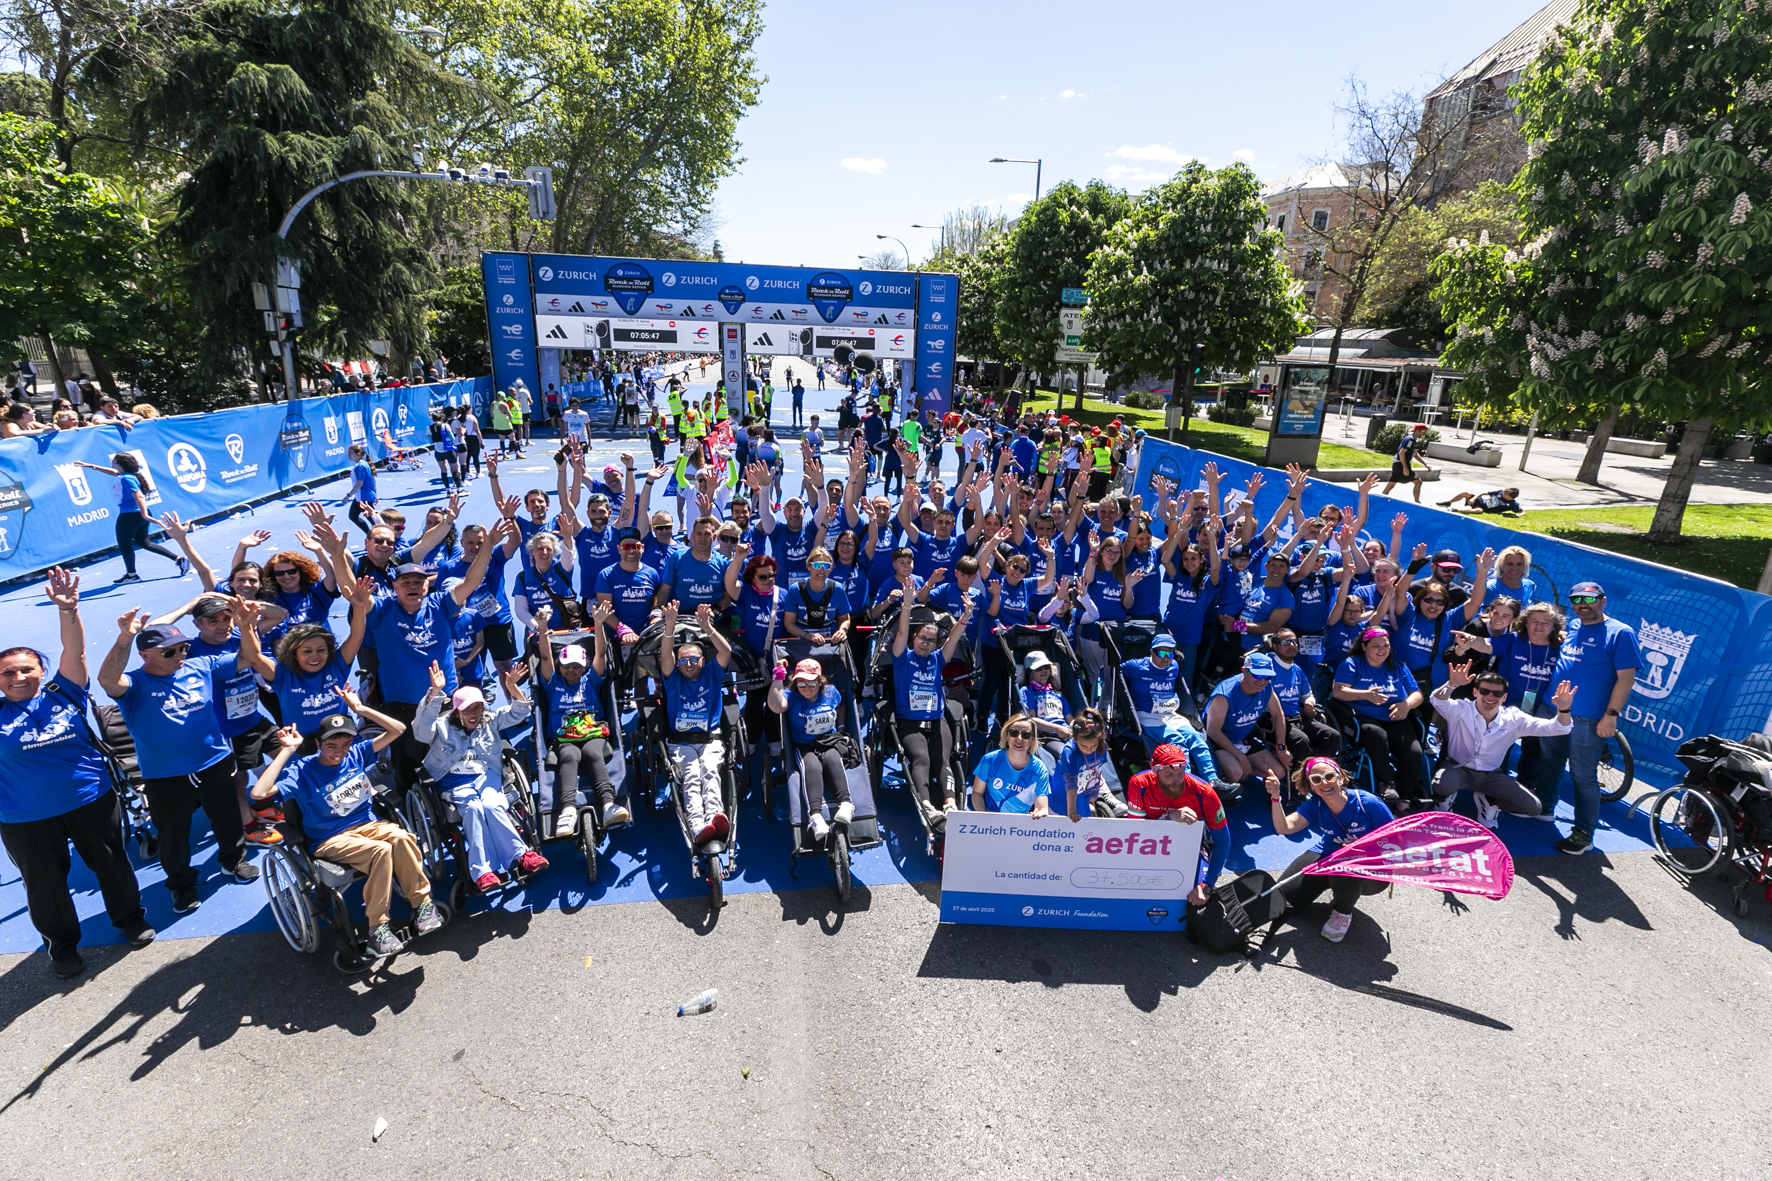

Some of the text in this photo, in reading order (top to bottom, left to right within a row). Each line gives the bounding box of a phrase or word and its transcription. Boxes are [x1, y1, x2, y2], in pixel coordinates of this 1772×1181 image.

[558, 270, 597, 280] ZURICH
[680, 275, 718, 285] ZURICH
[764, 280, 800, 289] ZURICH
[876, 285, 911, 294] ZURICH
[496, 307, 524, 315] ZURICH
[924, 323, 949, 331] ZURICH
[630, 332, 660, 340] 07:05:47
[325, 446, 345, 457] MADRID
[176, 470, 207, 485] MAPOMA
[67, 507, 110, 528] MADRID
[235, 693, 255, 704] 12032
[815, 717, 830, 725] SARA
[1619, 704, 1684, 742] DRID
[22, 733, 76, 751] #Imparables
[334, 770, 357, 787] ZURICH
[958, 824, 1075, 840] Z Zurich Foundation
[1430, 823, 1455, 831] frena
[1032, 841, 1074, 853] dona a:
[1085, 832, 1172, 856] aefat
[1381, 842, 1492, 876] aefat
[995, 870, 1063, 881] La cantidad de:
[1382, 860, 1493, 883] www.aefat.es
[1086, 870, 1164, 886] 37.500€
[1392, 872, 1431, 885] BIZUM
[1037, 908, 1070, 917] ZURICH
[1073, 910, 1109, 918] Foundation
